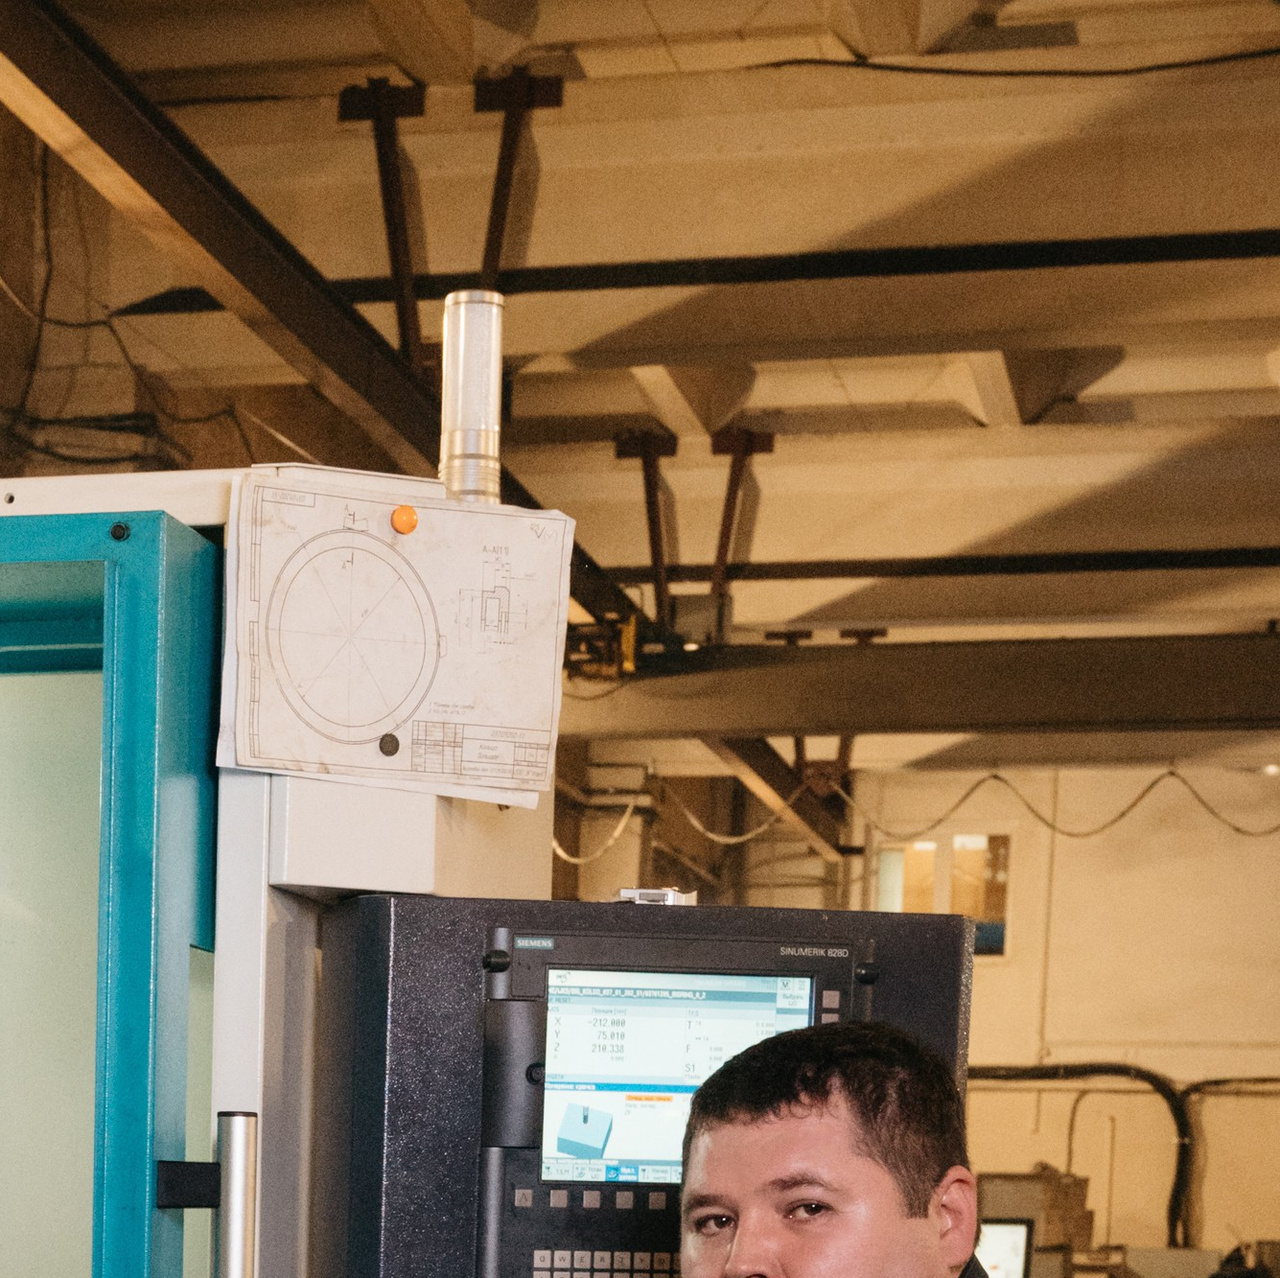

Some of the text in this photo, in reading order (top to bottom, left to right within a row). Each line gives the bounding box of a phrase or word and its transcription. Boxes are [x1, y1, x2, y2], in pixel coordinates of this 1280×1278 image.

[517, 939, 553, 948] SIEMENS
[780, 947, 849, 958] SINUMERIK 828D
